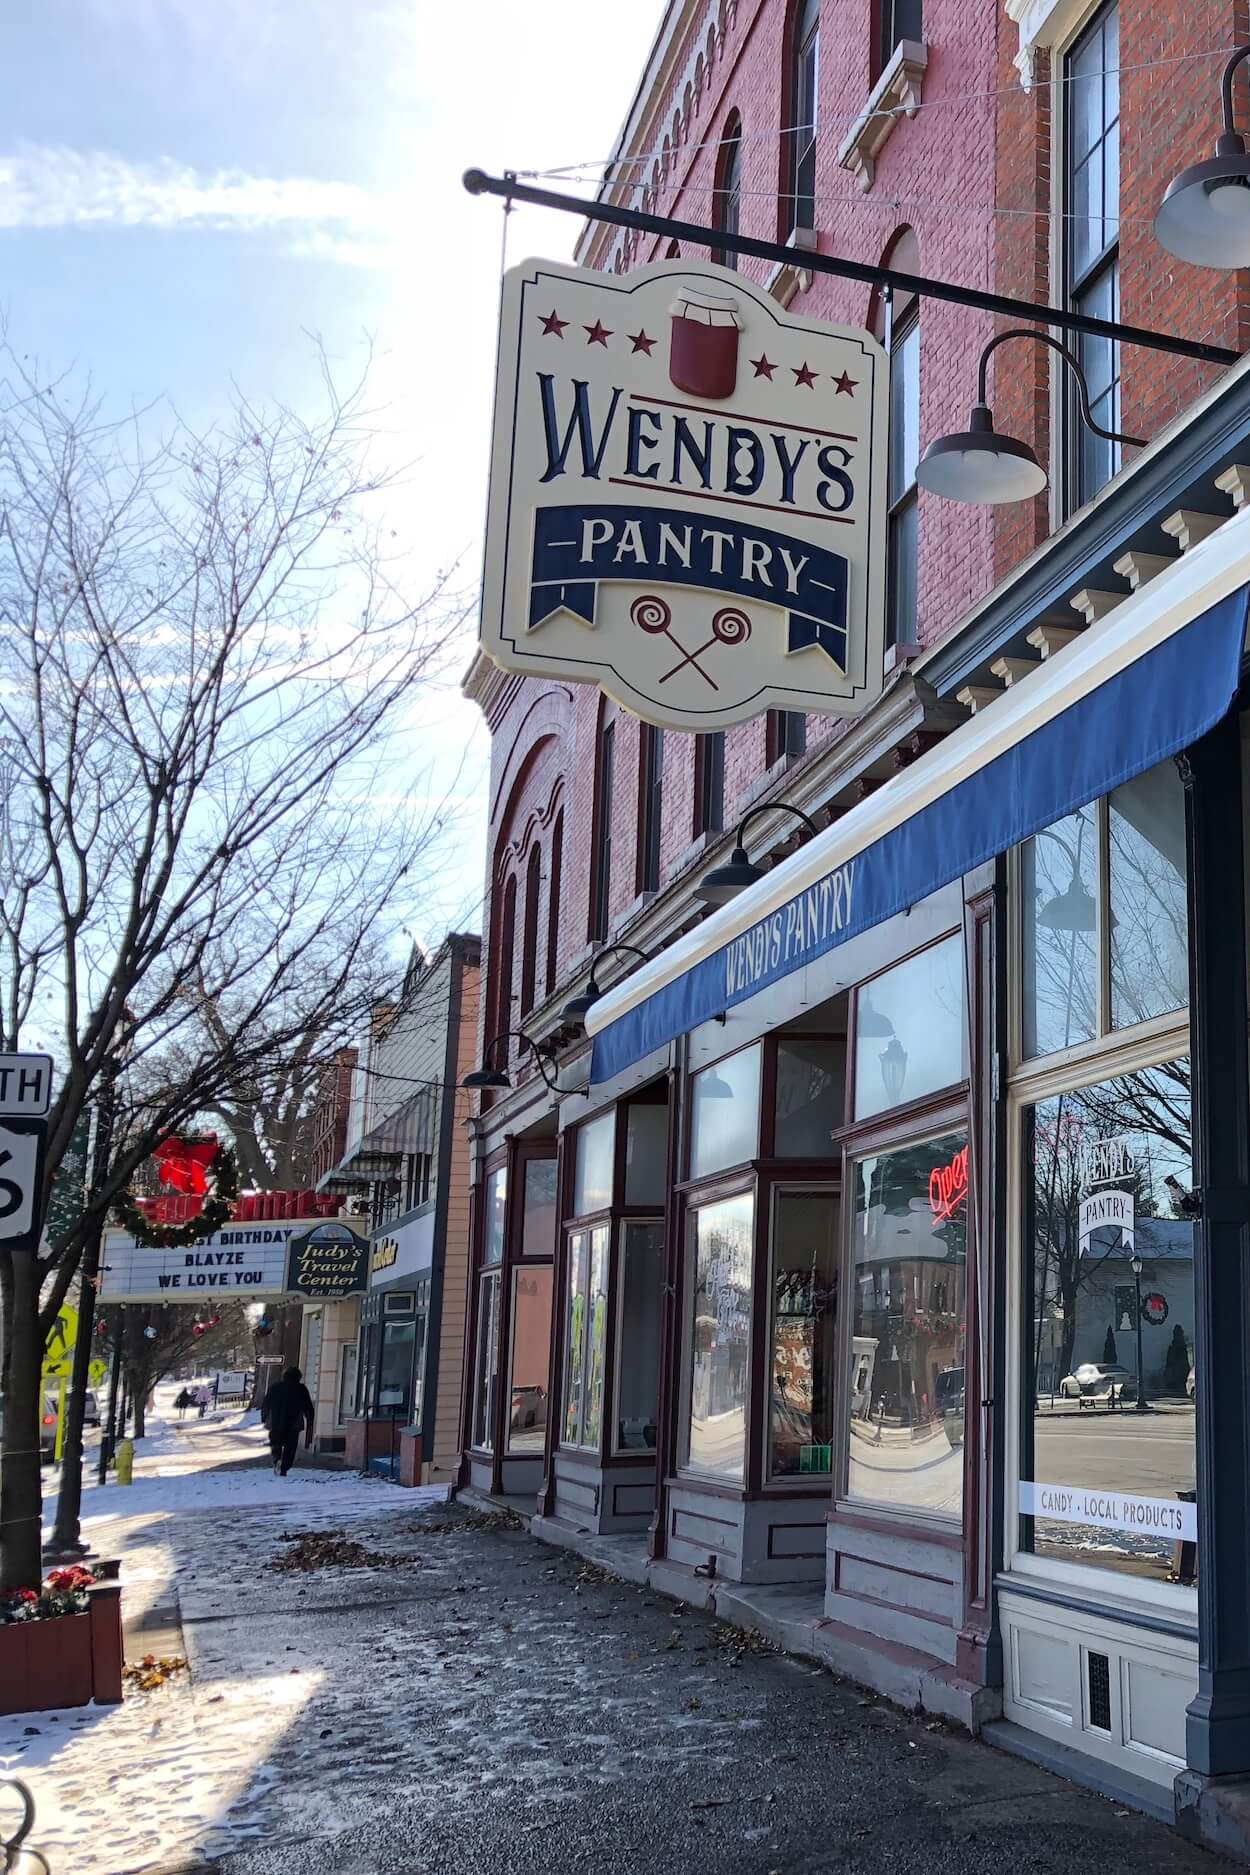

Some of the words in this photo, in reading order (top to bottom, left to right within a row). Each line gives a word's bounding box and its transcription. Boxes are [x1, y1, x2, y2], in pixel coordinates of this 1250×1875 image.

[536, 372, 855, 512] WENDY'S
[579, 519, 811, 595] PANTRY
[783, 861, 855, 961] PANTRY
[1086, 1197, 1126, 1225] PANTRY
[220, 1230, 293, 1246] BIRTHDAY
[185, 1252, 245, 1267] BLAYZE
[297, 1244, 363, 1260] Judy's
[300, 1259, 357, 1272] Travel
[158, 1274, 181, 1288] WE
[187, 1273, 228, 1287] LOVE
[235, 1271, 263, 1285] YOU
[297, 1272, 359, 1286] Center
[1041, 1491, 1073, 1513] CANDY
[1084, 1496, 1118, 1521] LOCAL
[1123, 1502, 1182, 1530] PRODUCTS
